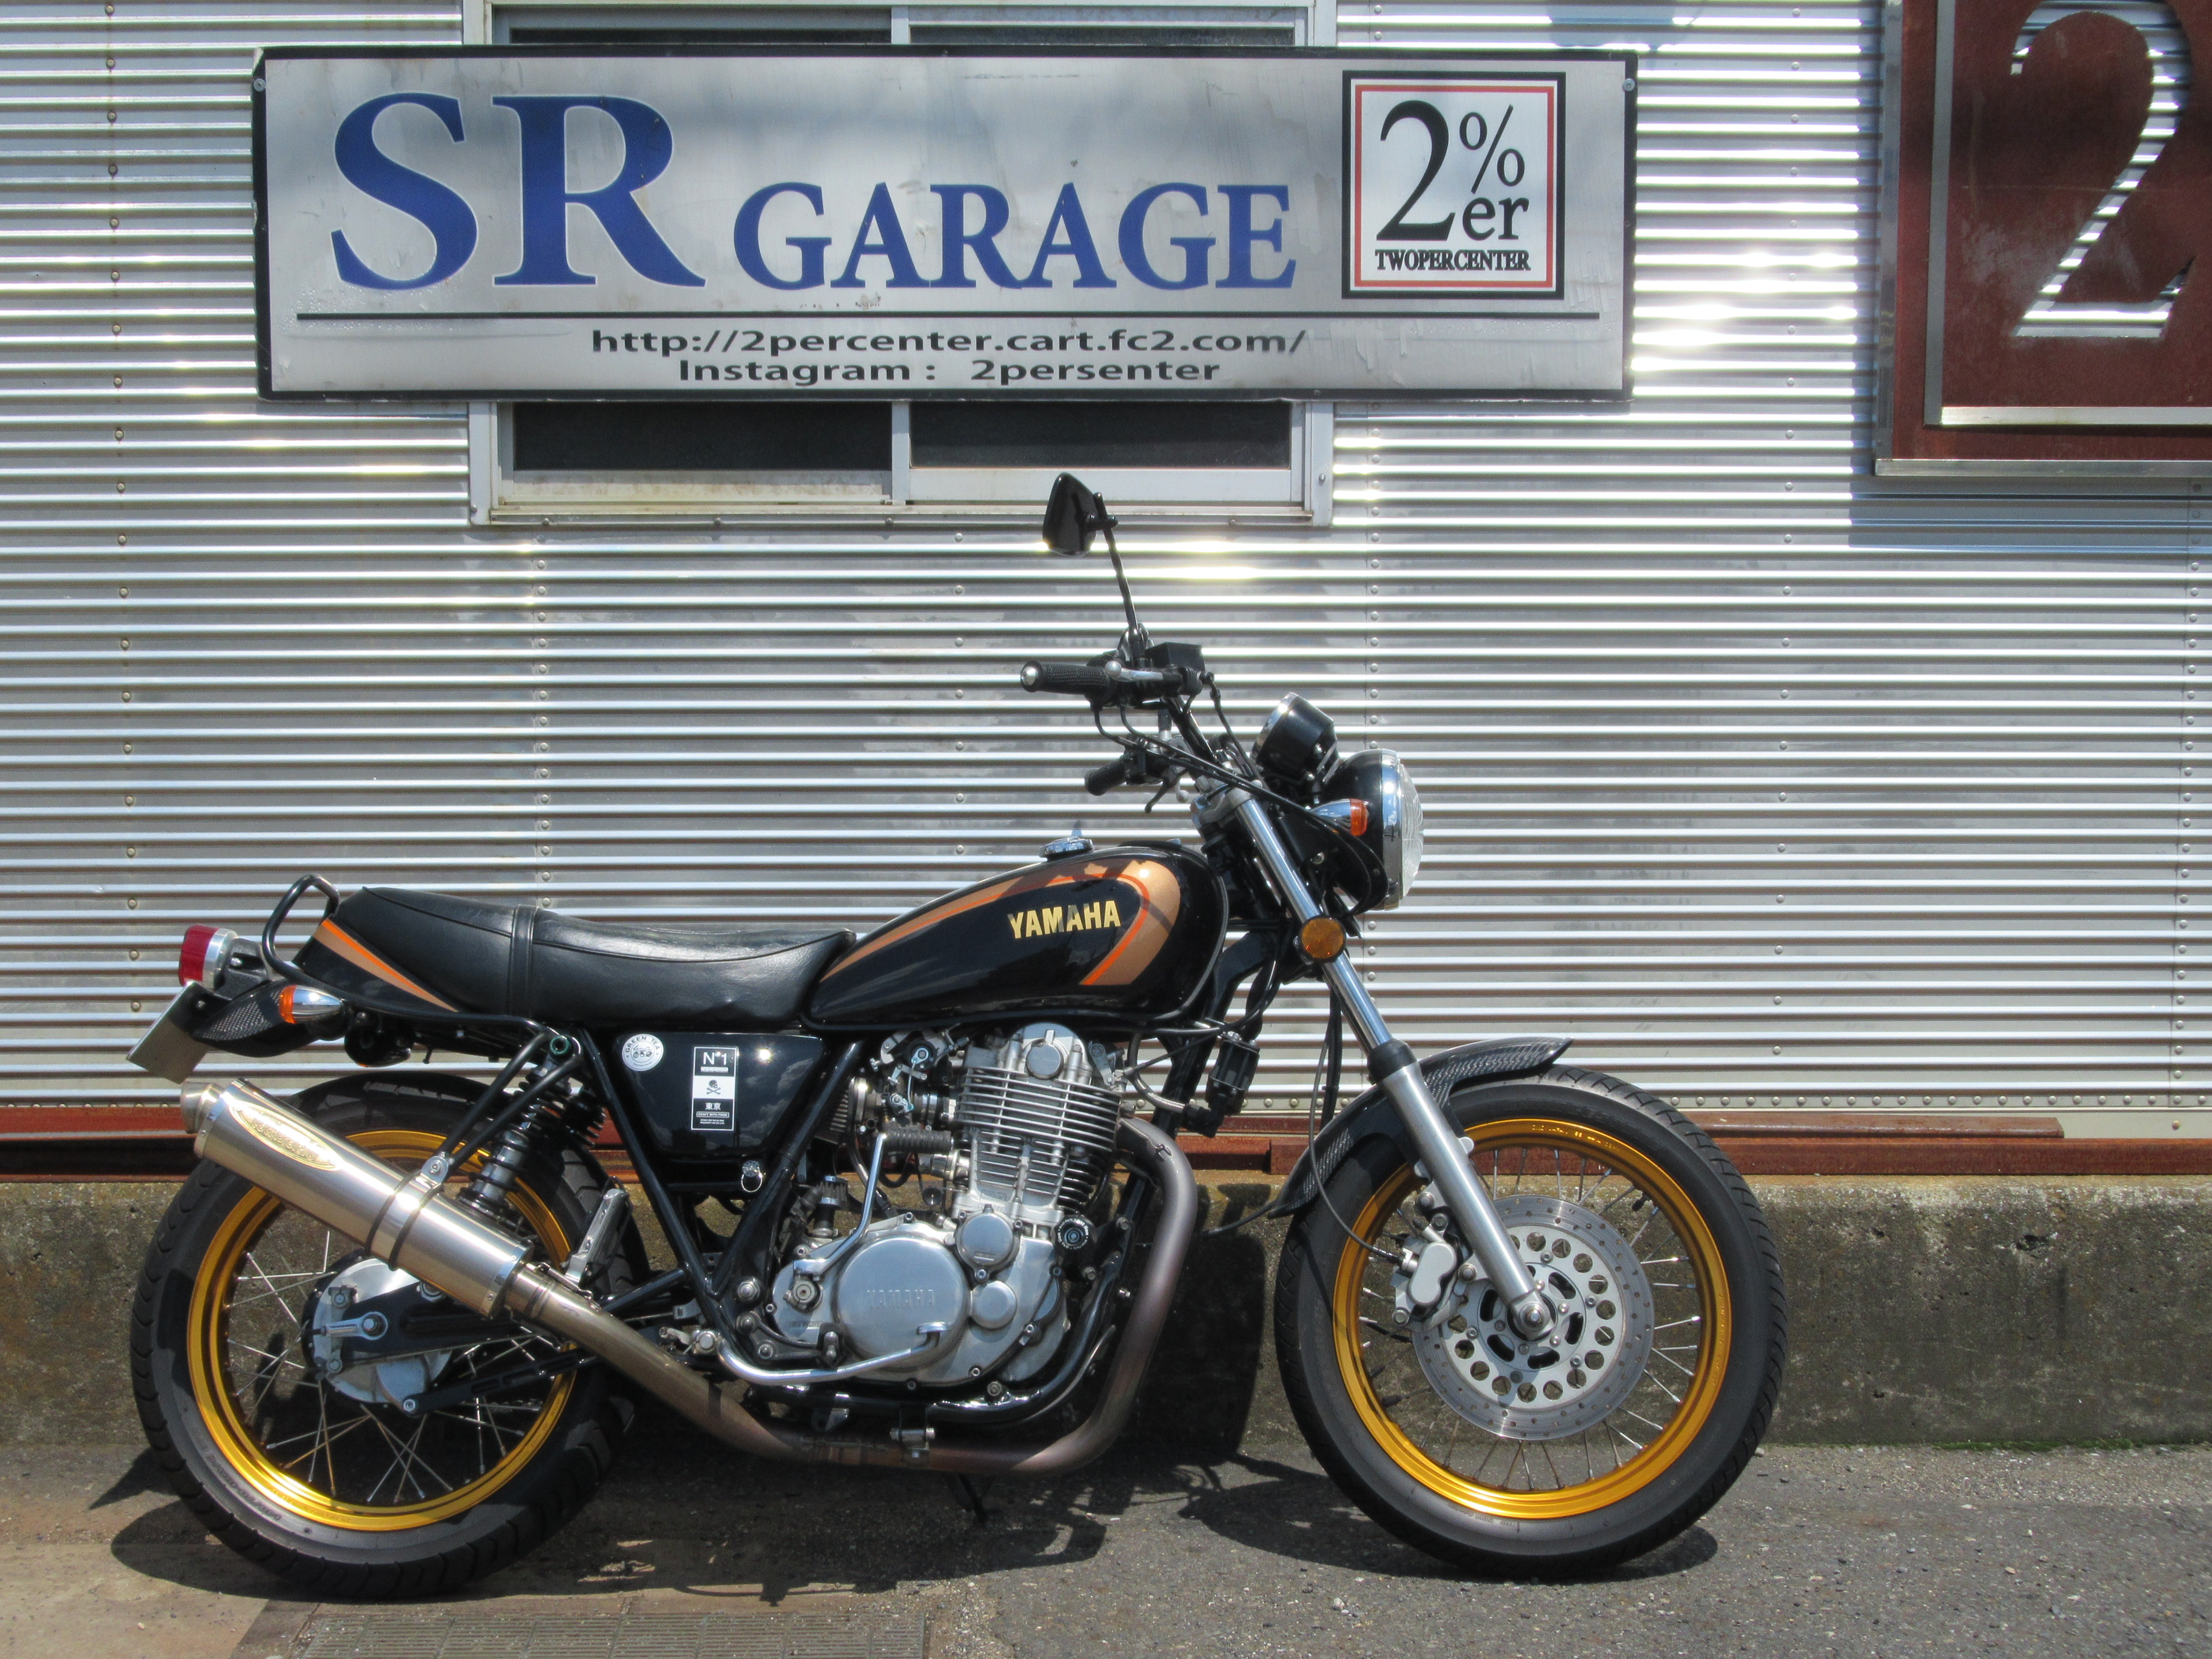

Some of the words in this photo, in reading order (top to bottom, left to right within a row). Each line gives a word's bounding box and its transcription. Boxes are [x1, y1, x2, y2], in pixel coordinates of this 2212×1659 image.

[2009, 0, 2191, 338] 2
[332, 92, 706, 291] SR
[734, 181, 1296, 290] GARAGE
[1375, 249, 1530, 271] TWOPERCENTER
[592, 329, 1305, 357] http://2percenter.cart.fc2.com/
[680, 360, 910, 386] Instagram
[971, 359, 1221, 386] 2persenter
[1007, 900, 1122, 939] YAMAHA
[625, 1036, 647, 1053] GREEN
[651, 1037, 660, 1050] TEA
[705, 1102, 722, 1111] 東京
[866, 1289, 936, 1309] YAMAHA
